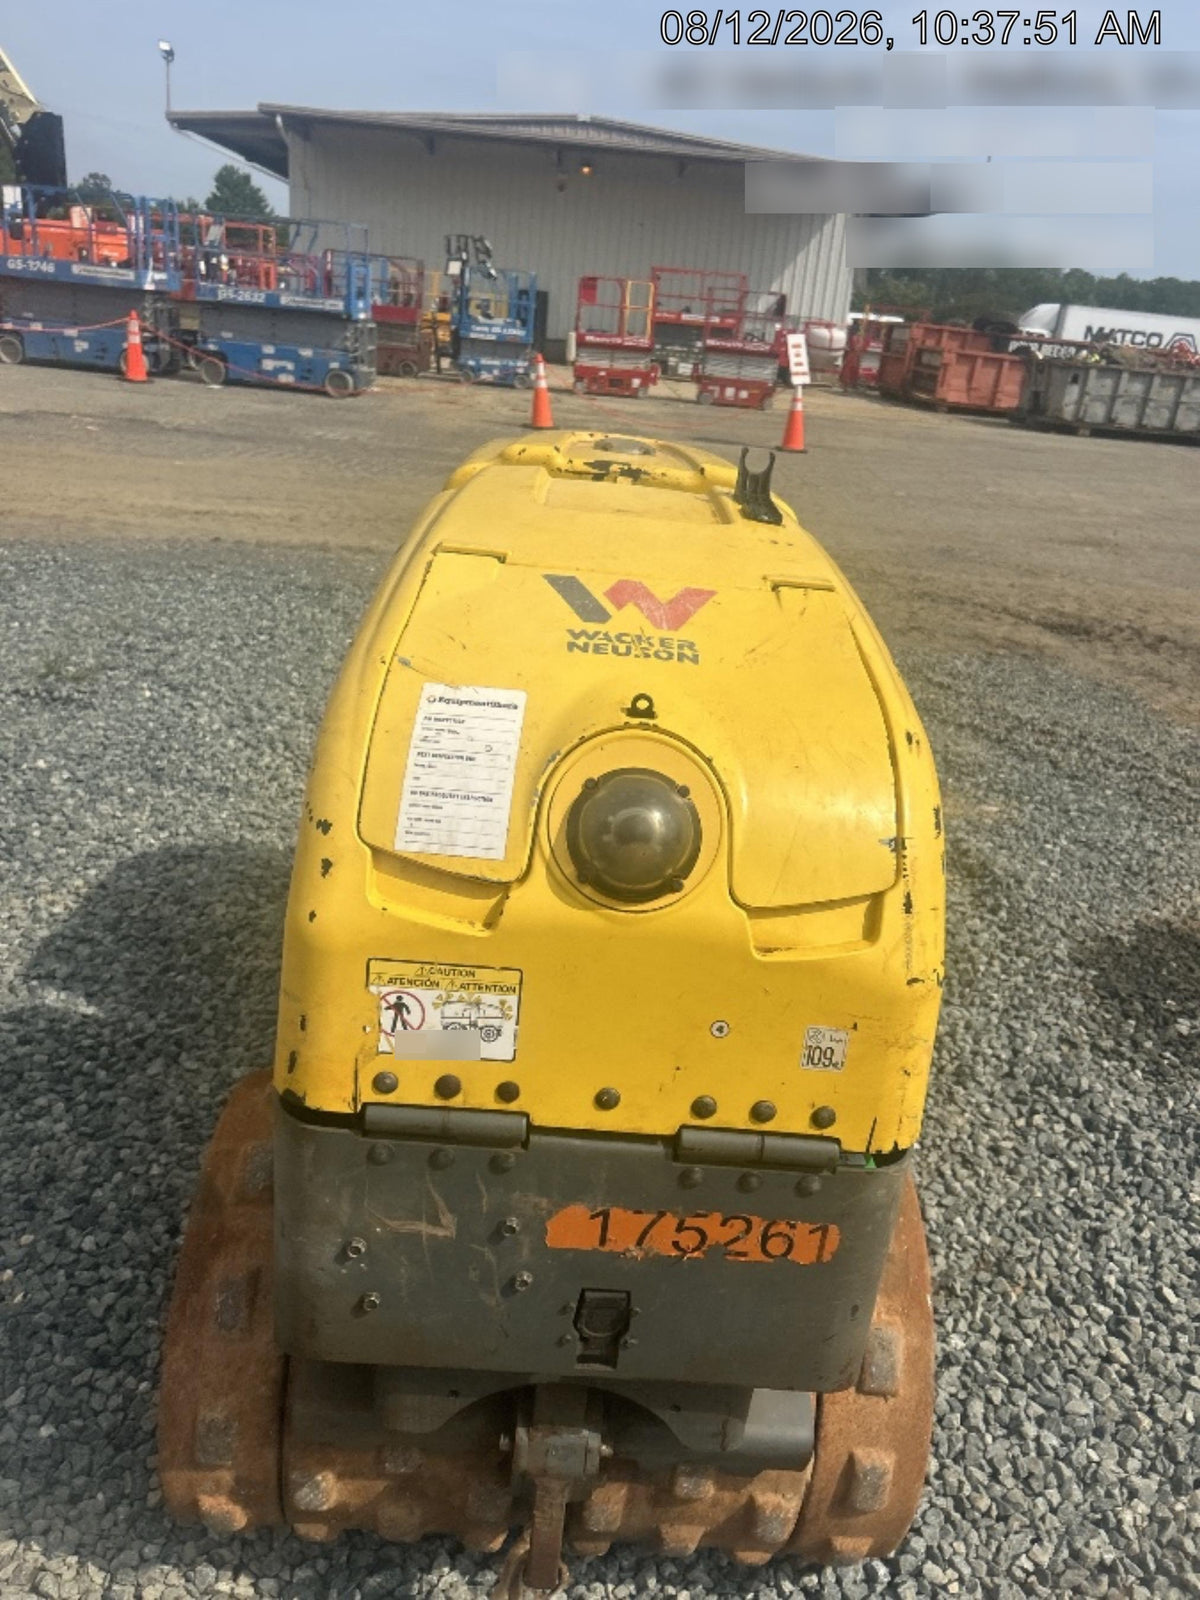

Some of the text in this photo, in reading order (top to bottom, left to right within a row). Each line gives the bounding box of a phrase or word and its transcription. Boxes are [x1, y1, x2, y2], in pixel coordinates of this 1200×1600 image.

[1084, 325, 1164, 348] MATCO
[566, 628, 699, 653] WACKER
[566, 641, 700, 665] NEUSON
[387, 977, 440, 988] ATENCIÓN
[428, 967, 476, 978] CAUTION
[459, 982, 517, 994] ATTENTION
[806, 1045, 834, 1067] 109
[589, 1207, 830, 1263] 175261
